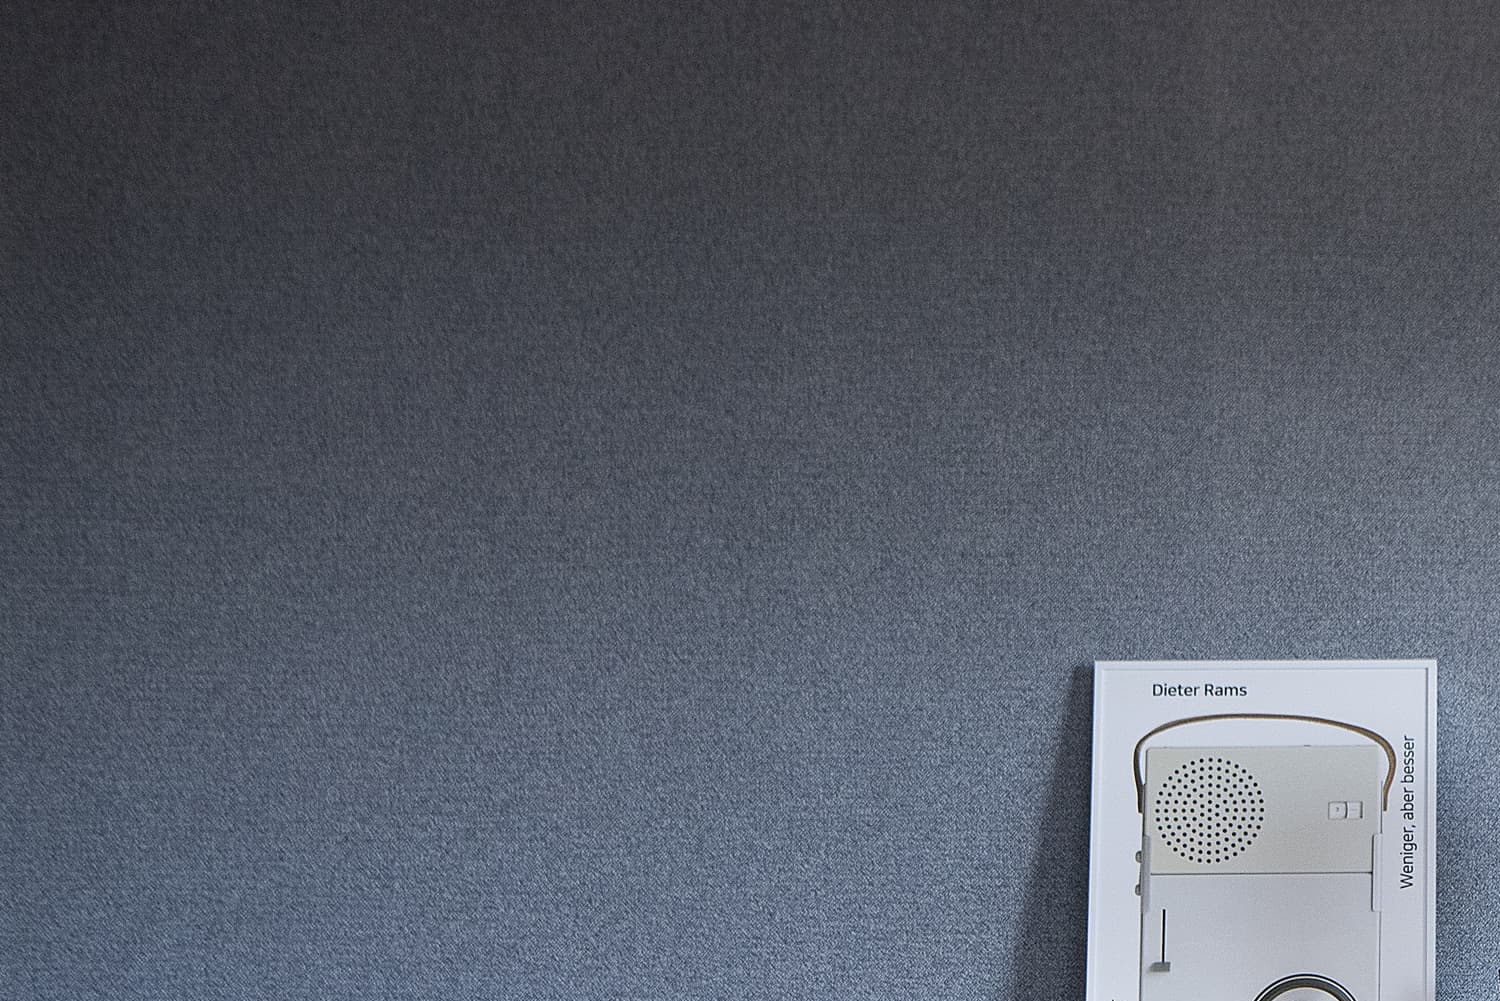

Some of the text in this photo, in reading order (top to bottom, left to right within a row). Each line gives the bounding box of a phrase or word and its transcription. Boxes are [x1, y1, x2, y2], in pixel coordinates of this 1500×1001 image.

[1152, 683, 1248, 697] Dieter Rams
[1400, 735, 1418, 889] Weniger, aber besser
